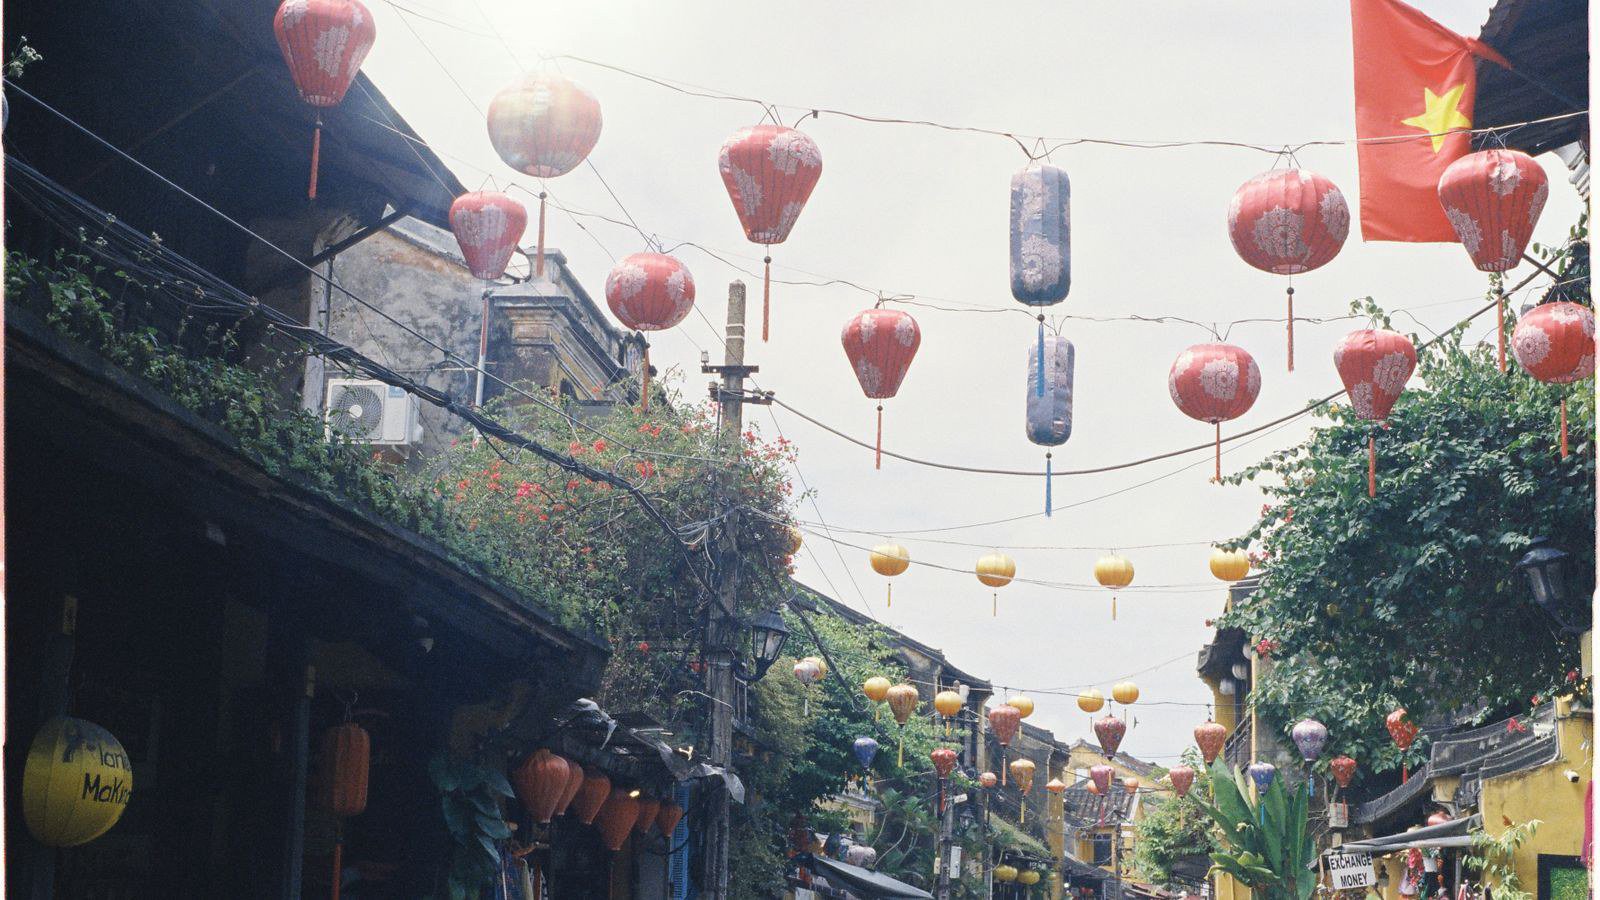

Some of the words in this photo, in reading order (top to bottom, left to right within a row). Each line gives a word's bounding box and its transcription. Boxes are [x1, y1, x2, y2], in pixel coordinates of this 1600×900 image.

[98, 743, 130, 771] lan
[1330, 854, 1372, 870] EXCHANGE
[1340, 872, 1367, 887] MONEY
